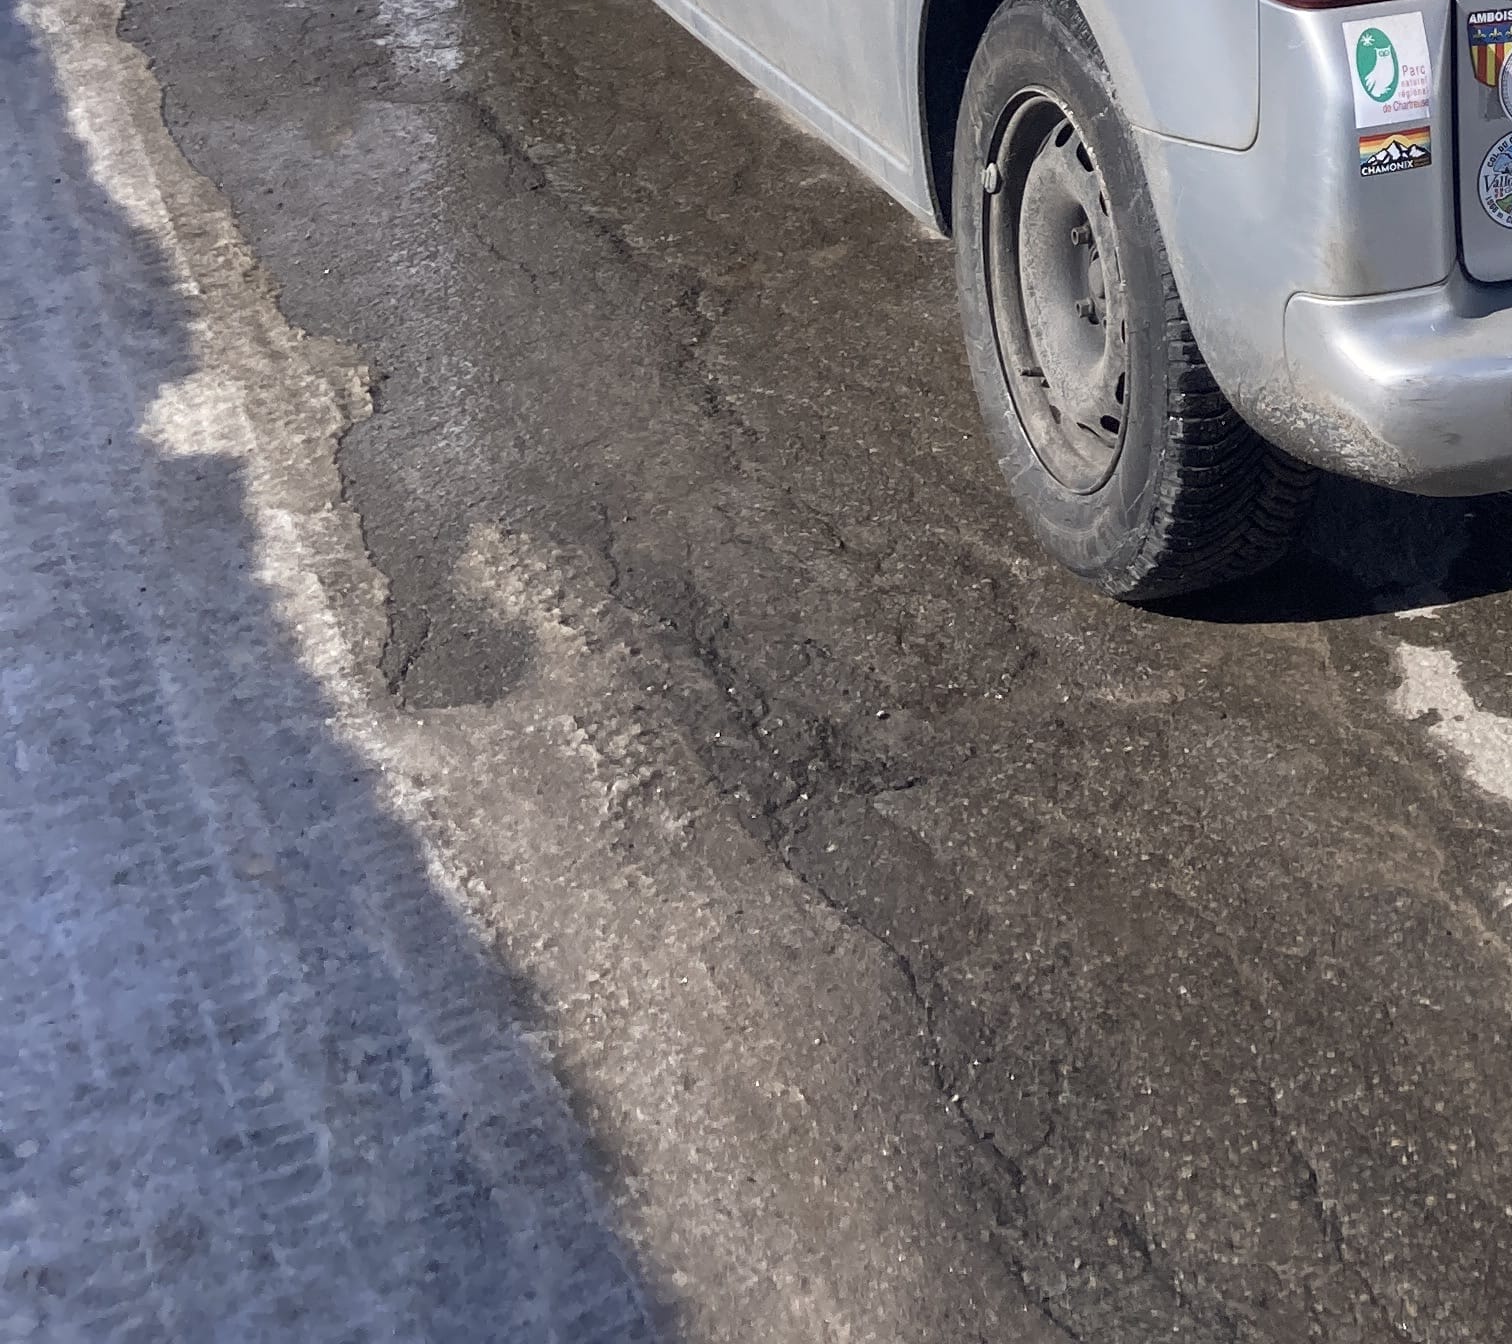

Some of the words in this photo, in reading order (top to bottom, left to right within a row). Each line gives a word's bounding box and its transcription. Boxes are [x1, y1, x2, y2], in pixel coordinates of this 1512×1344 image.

[1402, 64, 1425, 77] Parc
[1383, 105, 1391, 114] de
[1393, 98, 1429, 112] Chartreuse
[1487, 152, 1500, 167] COL
[1498, 141, 1508, 152] DU
[1361, 160, 1414, 175] CHAMONIX
